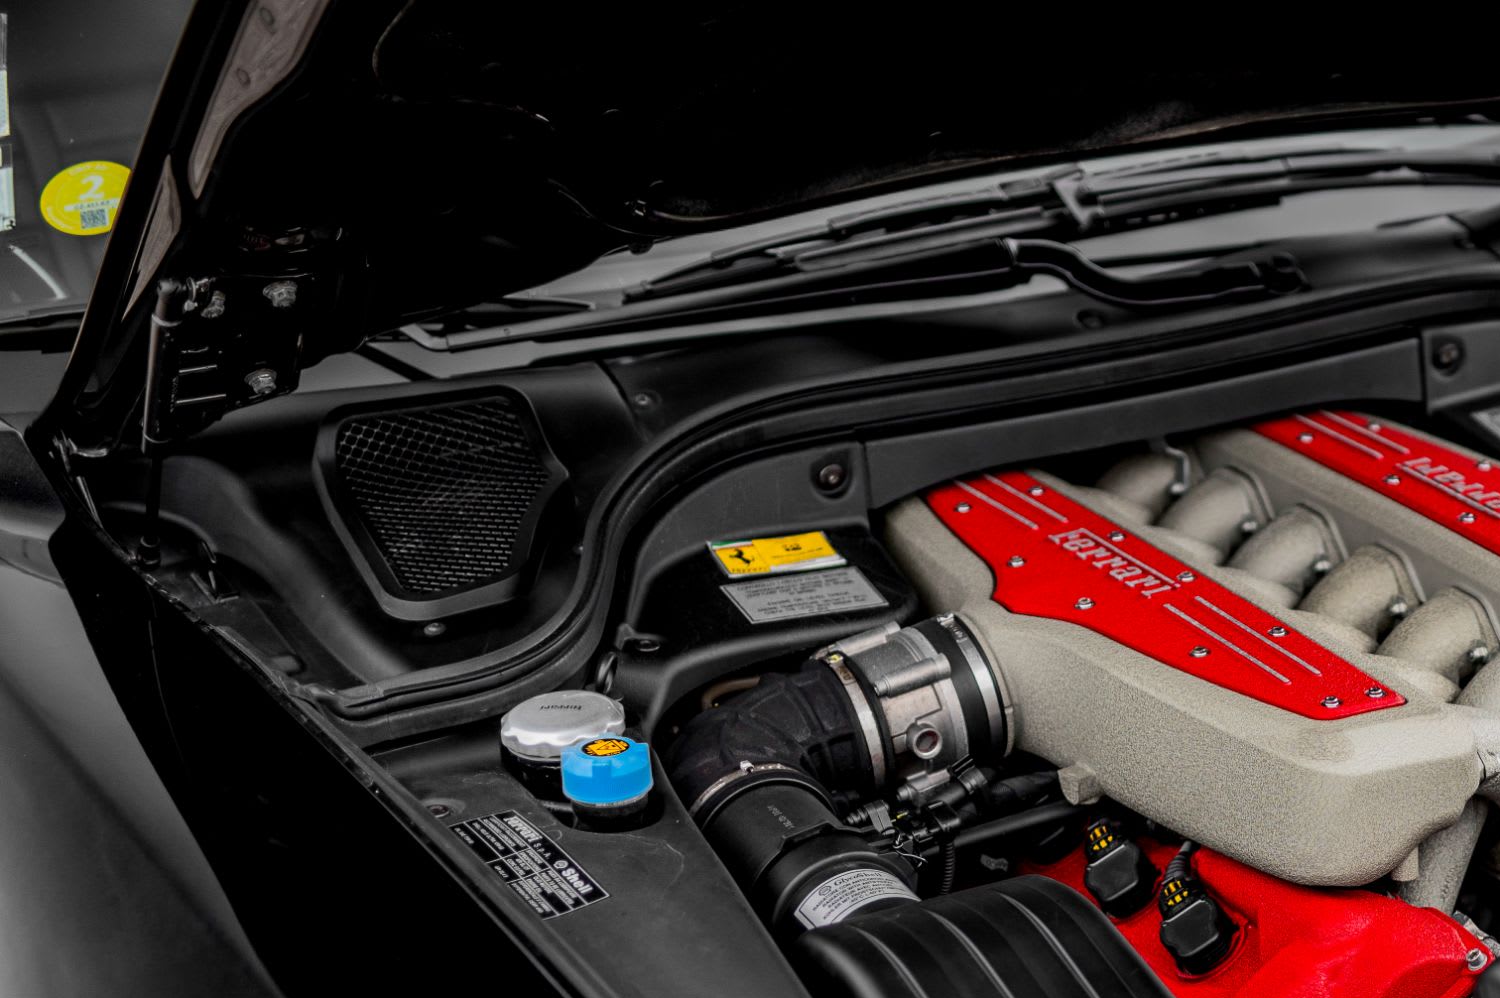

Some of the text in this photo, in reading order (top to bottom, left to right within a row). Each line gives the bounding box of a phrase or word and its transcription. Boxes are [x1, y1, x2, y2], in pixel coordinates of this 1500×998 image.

[79, 174, 105, 200] 2
[1048, 528, 1181, 599] Ferrari
[503, 815, 543, 842] Ferrari
[561, 868, 594, 894] Shell
